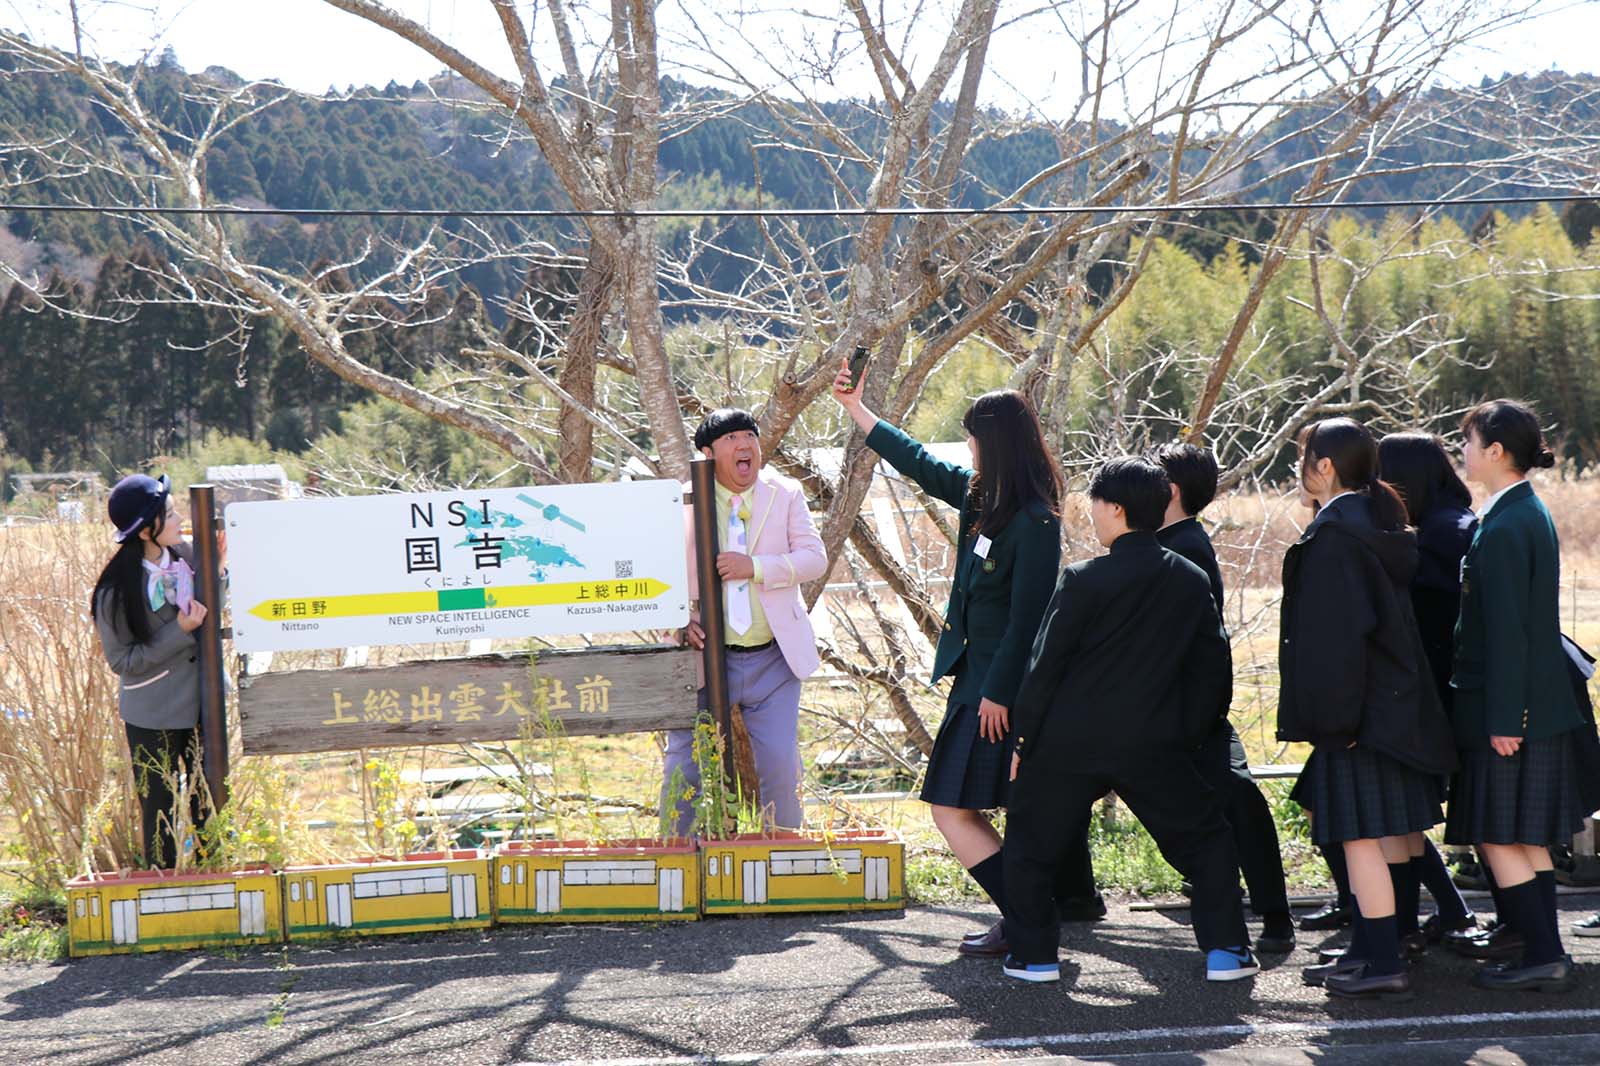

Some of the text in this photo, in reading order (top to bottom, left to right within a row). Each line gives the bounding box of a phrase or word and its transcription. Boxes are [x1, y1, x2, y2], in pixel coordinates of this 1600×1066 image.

[411, 499, 492, 528] NSI
[405, 532, 505, 574] 国吉
[424, 574, 492, 588] くによし
[576, 582, 648, 599] 上総中川
[272, 601, 327, 617] 新田野
[388, 608, 531, 625] NEW SPACE INTELLIGENCE
[567, 602, 659, 615] Kazusa-Nakagawa
[281, 622, 320, 631] Nittano
[436, 623, 485, 636] Kuniyoshi
[322, 674, 612, 725] 上総出雲大社前
